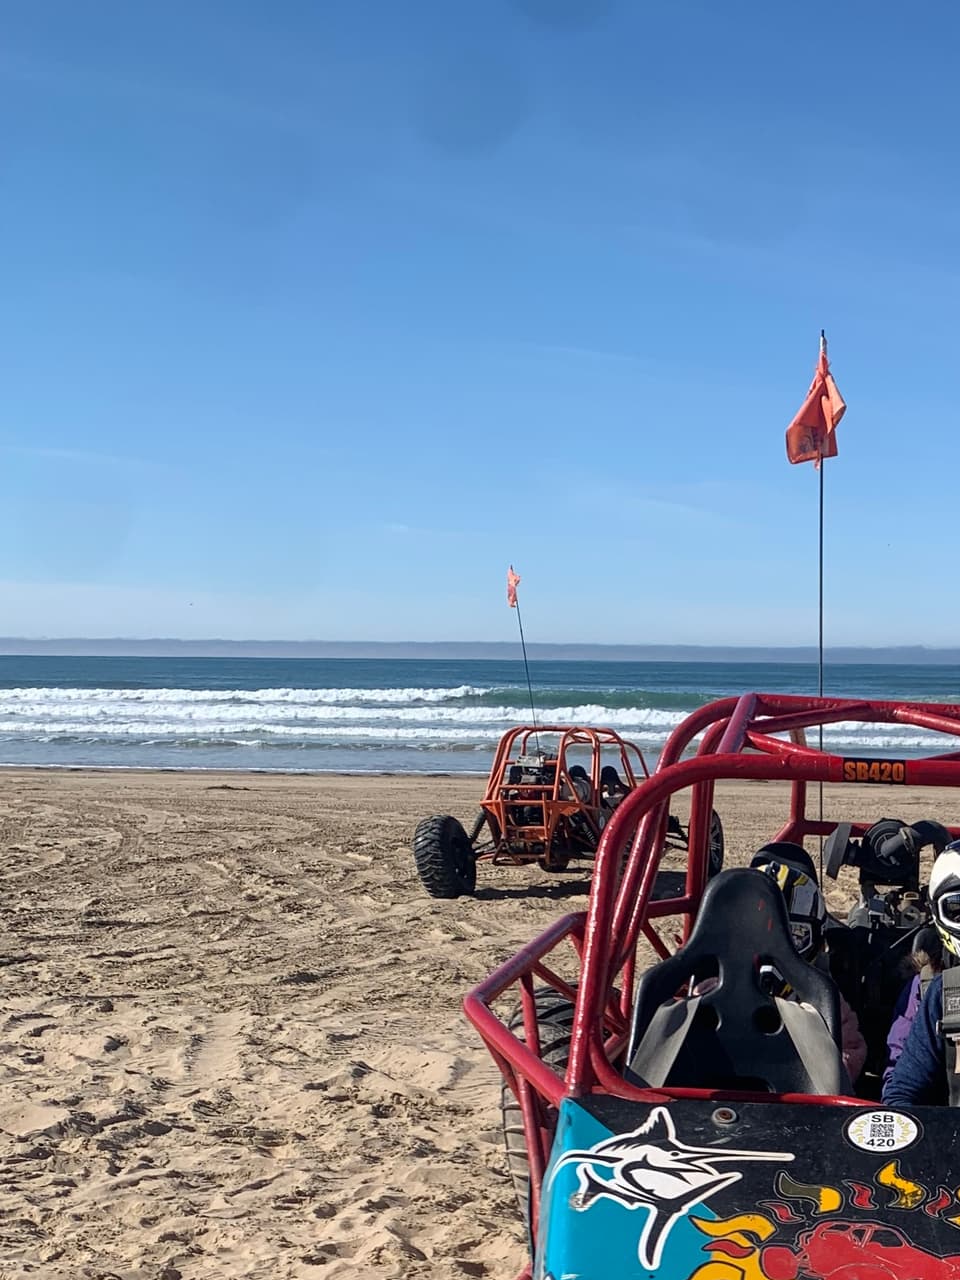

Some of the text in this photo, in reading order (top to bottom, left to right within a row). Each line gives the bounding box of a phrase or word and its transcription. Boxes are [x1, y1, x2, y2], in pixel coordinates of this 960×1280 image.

[844, 761, 904, 781] SB420
[871, 1114, 895, 1123] SB
[866, 1138, 895, 1147] 420
